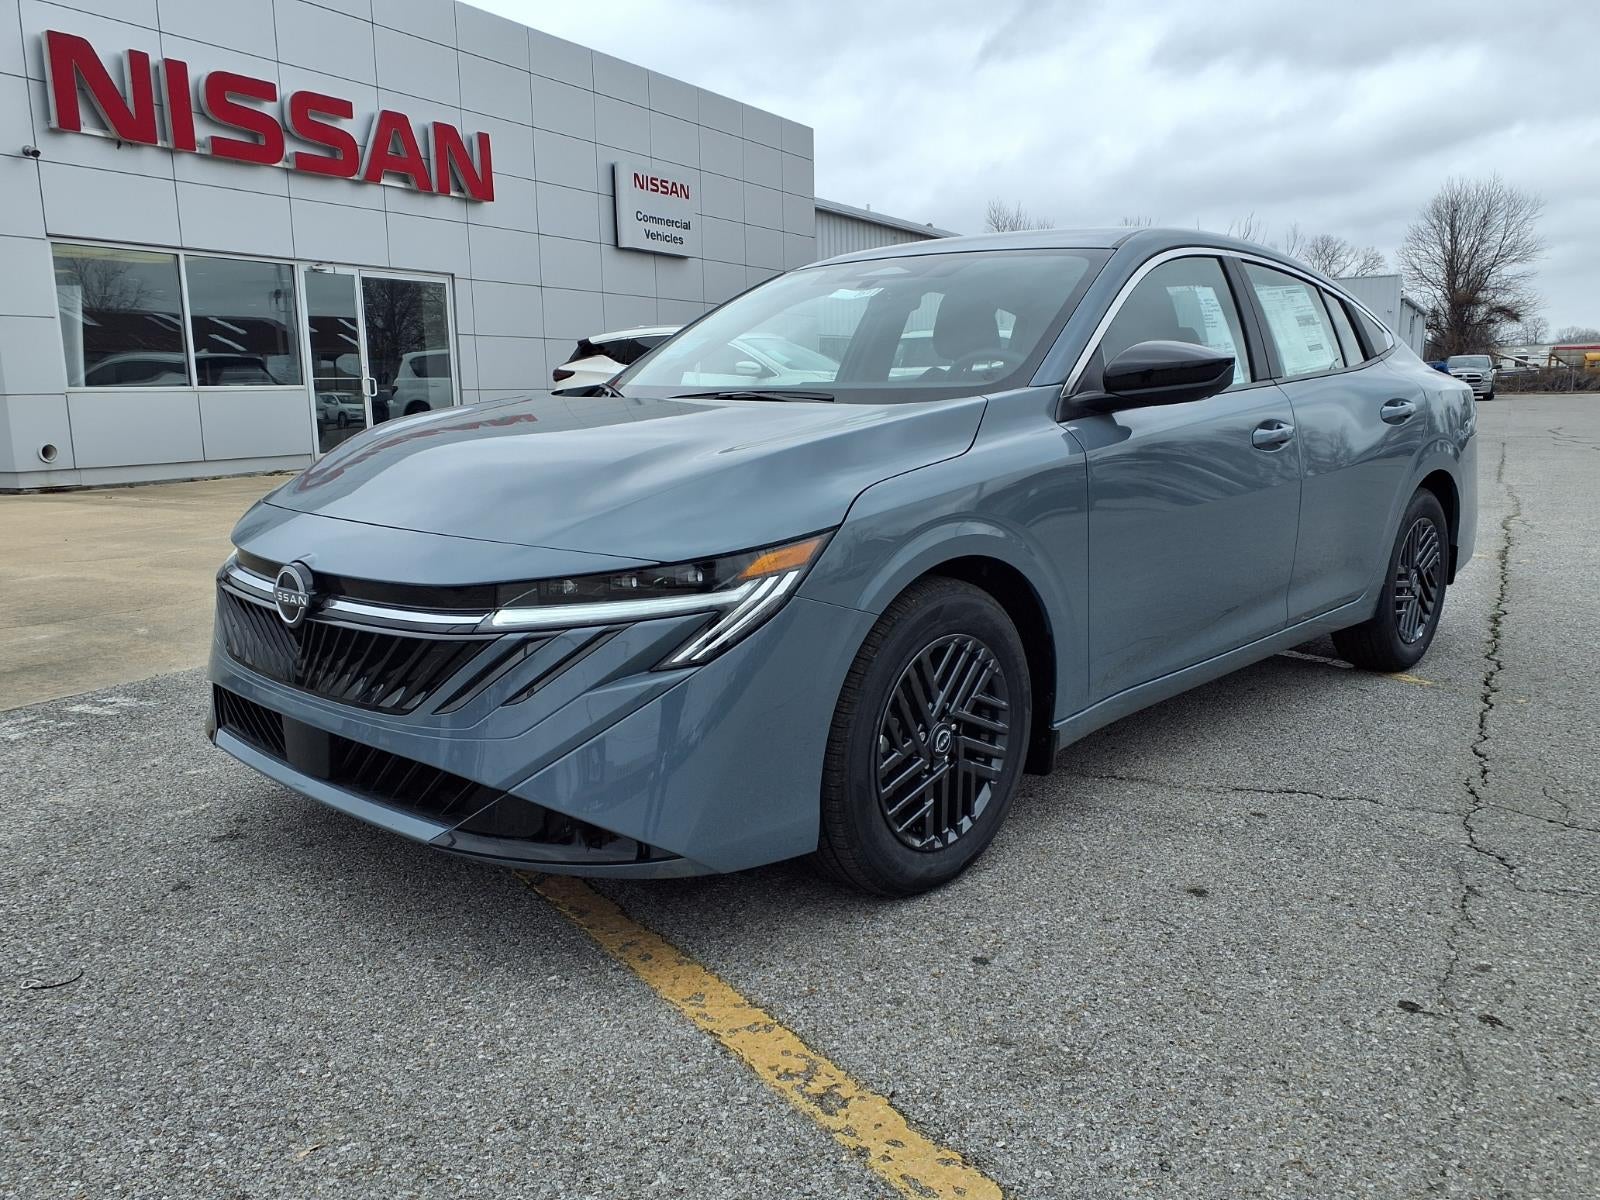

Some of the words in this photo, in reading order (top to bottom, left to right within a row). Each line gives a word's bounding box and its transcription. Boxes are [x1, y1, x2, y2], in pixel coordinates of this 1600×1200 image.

[43, 30, 494, 202] NISSAN
[633, 172, 690, 200] NISSAN
[635, 210, 691, 231] Commercial
[644, 228, 684, 245] Vehicles
[275, 591, 307, 606] SSAN
